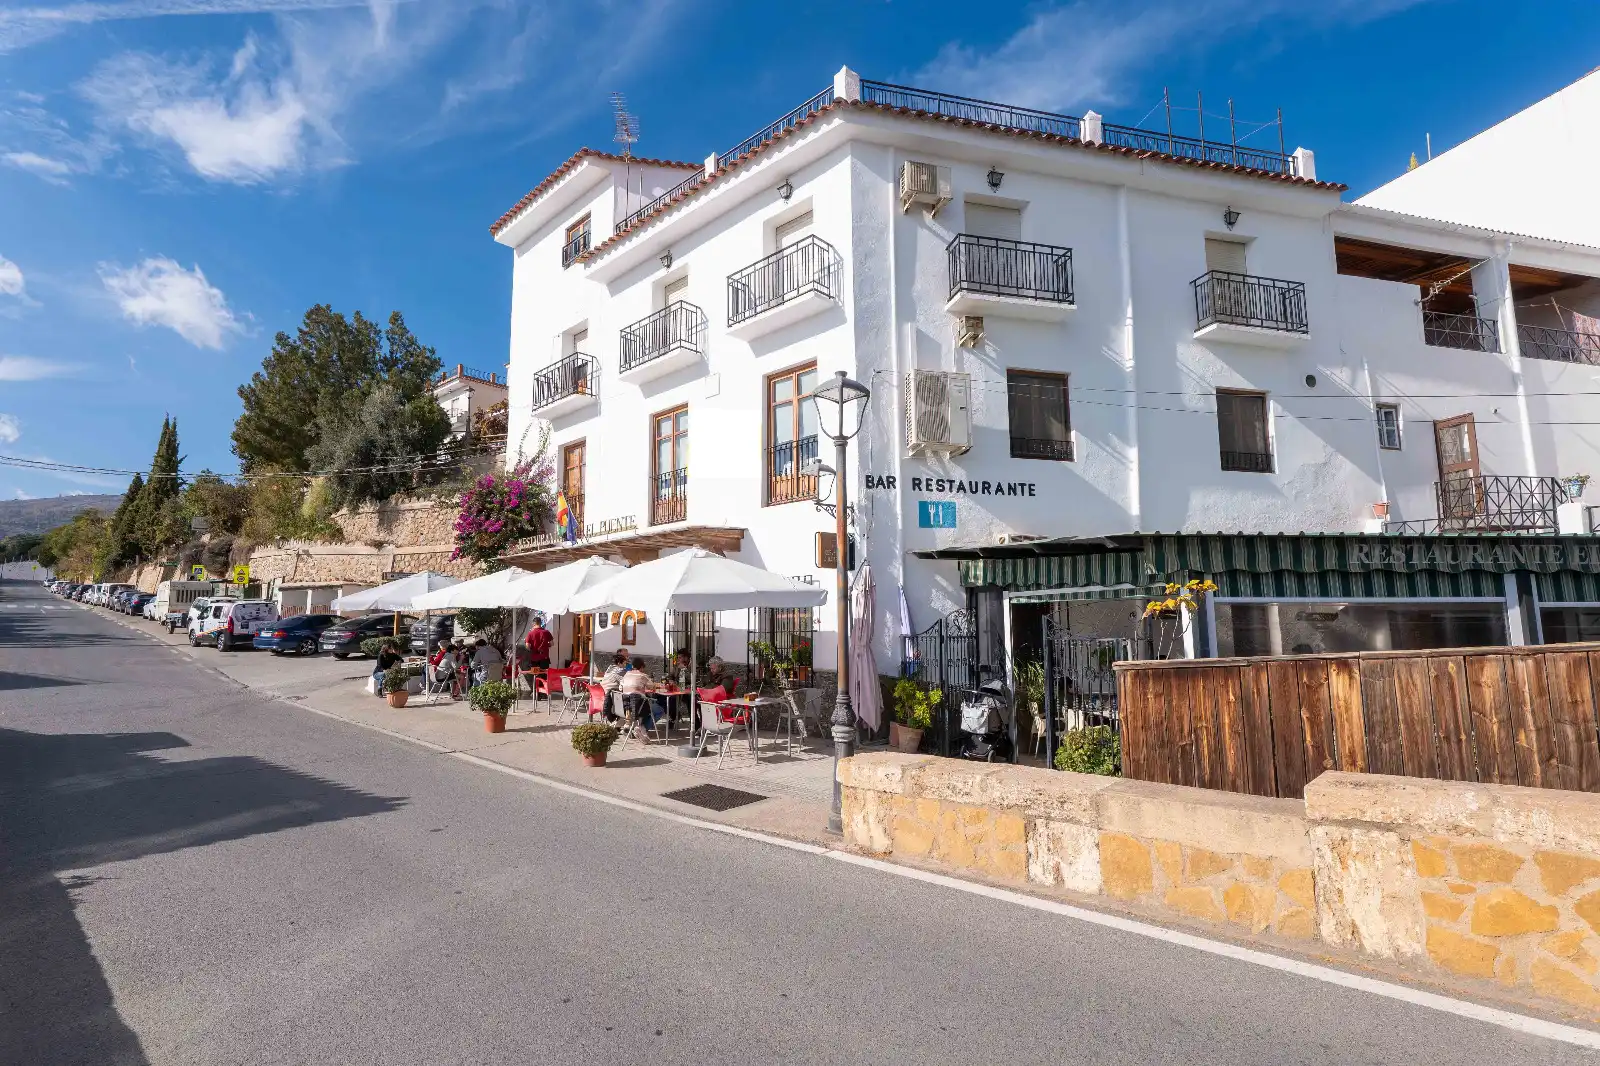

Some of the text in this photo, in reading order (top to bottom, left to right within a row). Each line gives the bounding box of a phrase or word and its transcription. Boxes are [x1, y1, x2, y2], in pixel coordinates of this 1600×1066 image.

[865, 474, 1036, 497] BAR RESTAURANTE
[600, 514, 637, 535] PUENTE
[1350, 544, 1565, 565] RESTAURANTE
